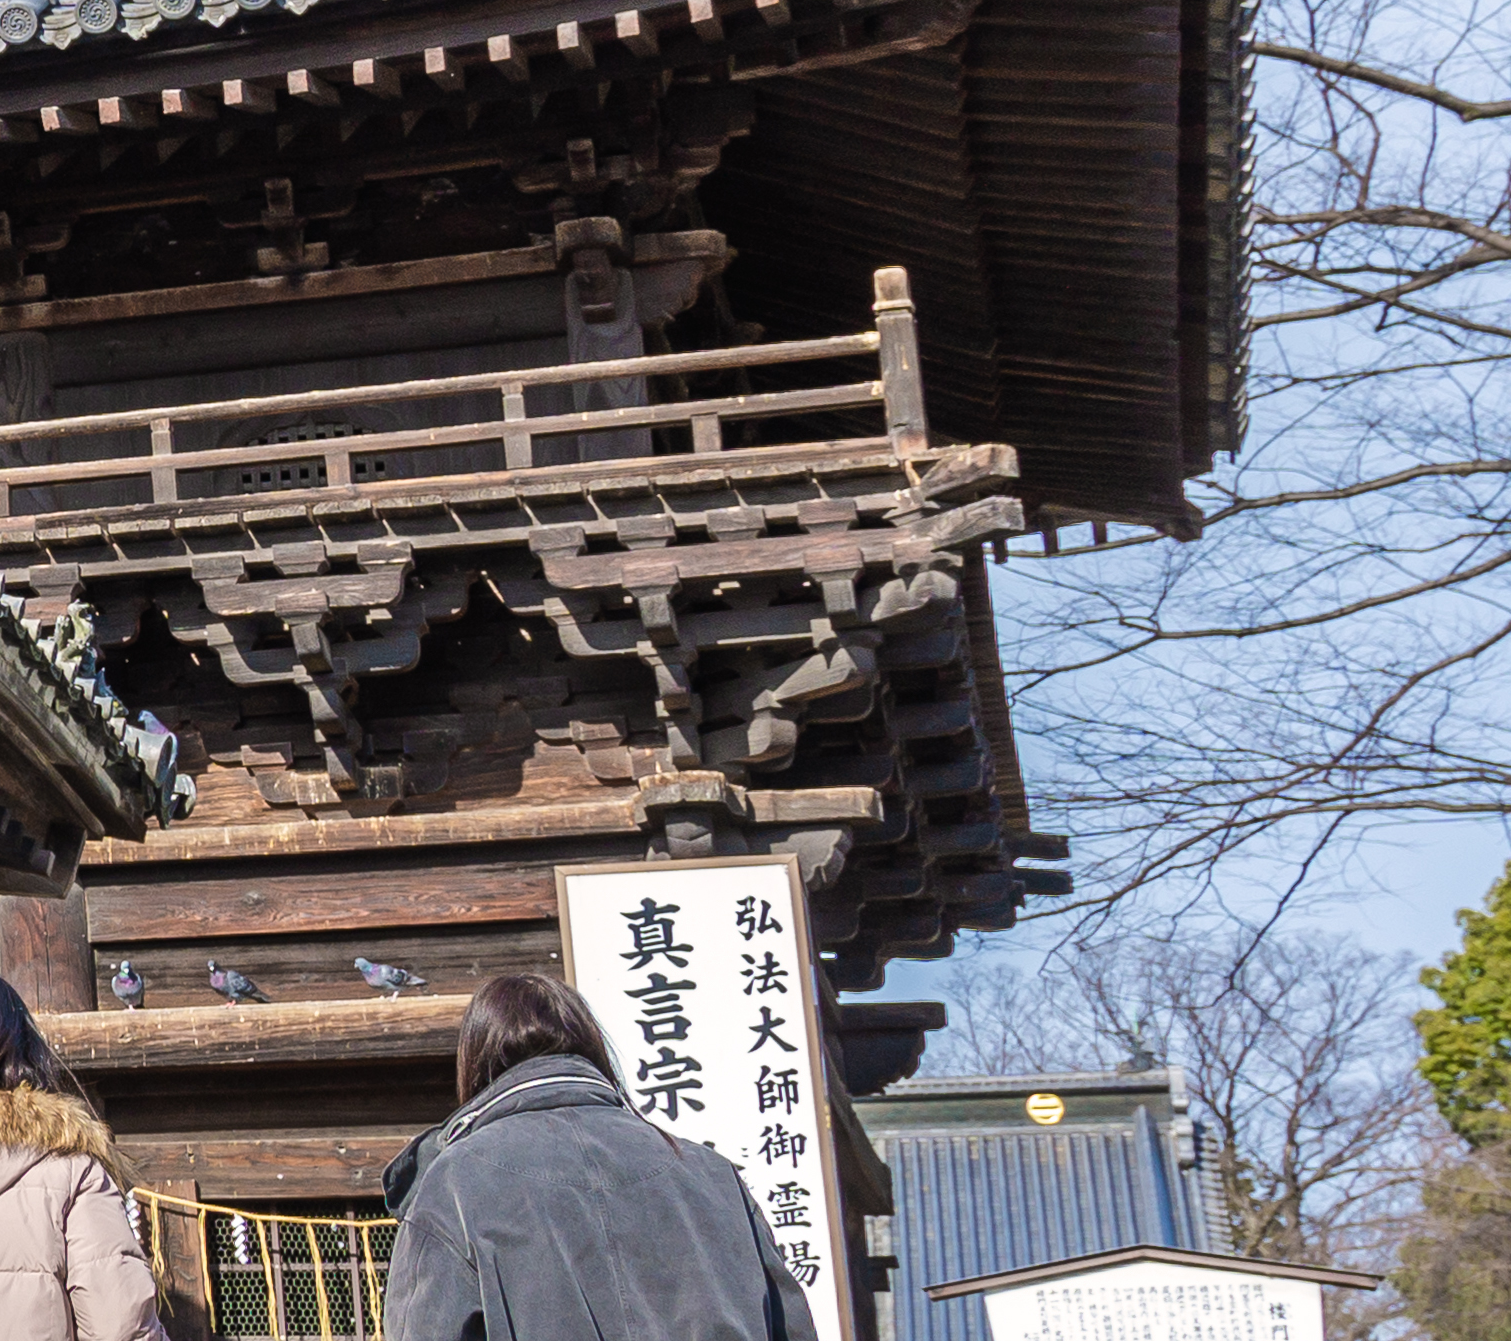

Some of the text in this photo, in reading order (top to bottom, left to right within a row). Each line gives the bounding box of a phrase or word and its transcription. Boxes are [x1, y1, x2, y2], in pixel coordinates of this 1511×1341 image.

[618, 897, 706, 1121] 真言宗
[734, 895, 821, 1288] 弘法大師御霊場
